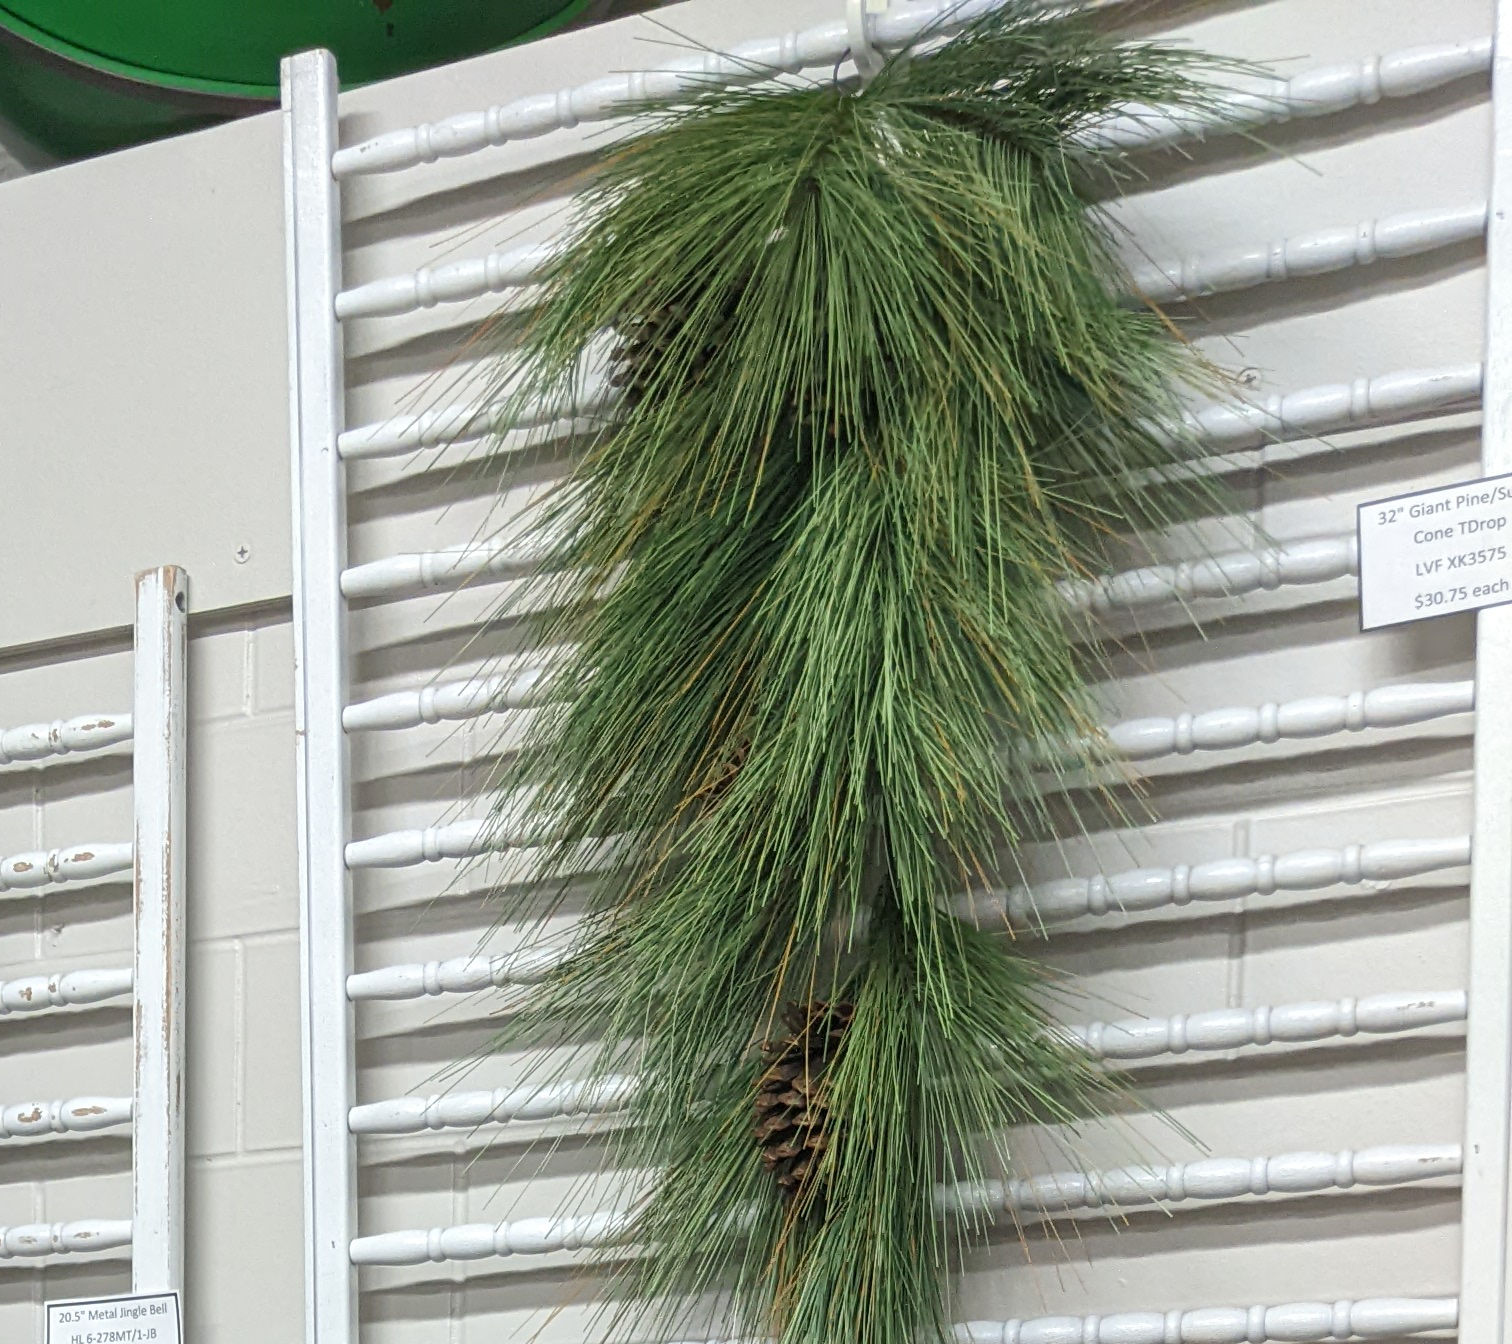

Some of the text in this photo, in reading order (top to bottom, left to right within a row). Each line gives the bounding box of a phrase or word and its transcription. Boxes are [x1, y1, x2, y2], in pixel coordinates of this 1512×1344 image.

[1378, 507, 1404, 526] 32"
[1409, 499, 1452, 519] Giant
[1413, 516, 1507, 544] Cone TDrop
[1416, 546, 1507, 577] LVF XK3575
[1414, 579, 1509, 610] $30.75 each
[59, 1303, 168, 1324] 20.5" Metal Jingle Bell
[71, 1328, 157, 1344] HL 6-278MT/1-JB
